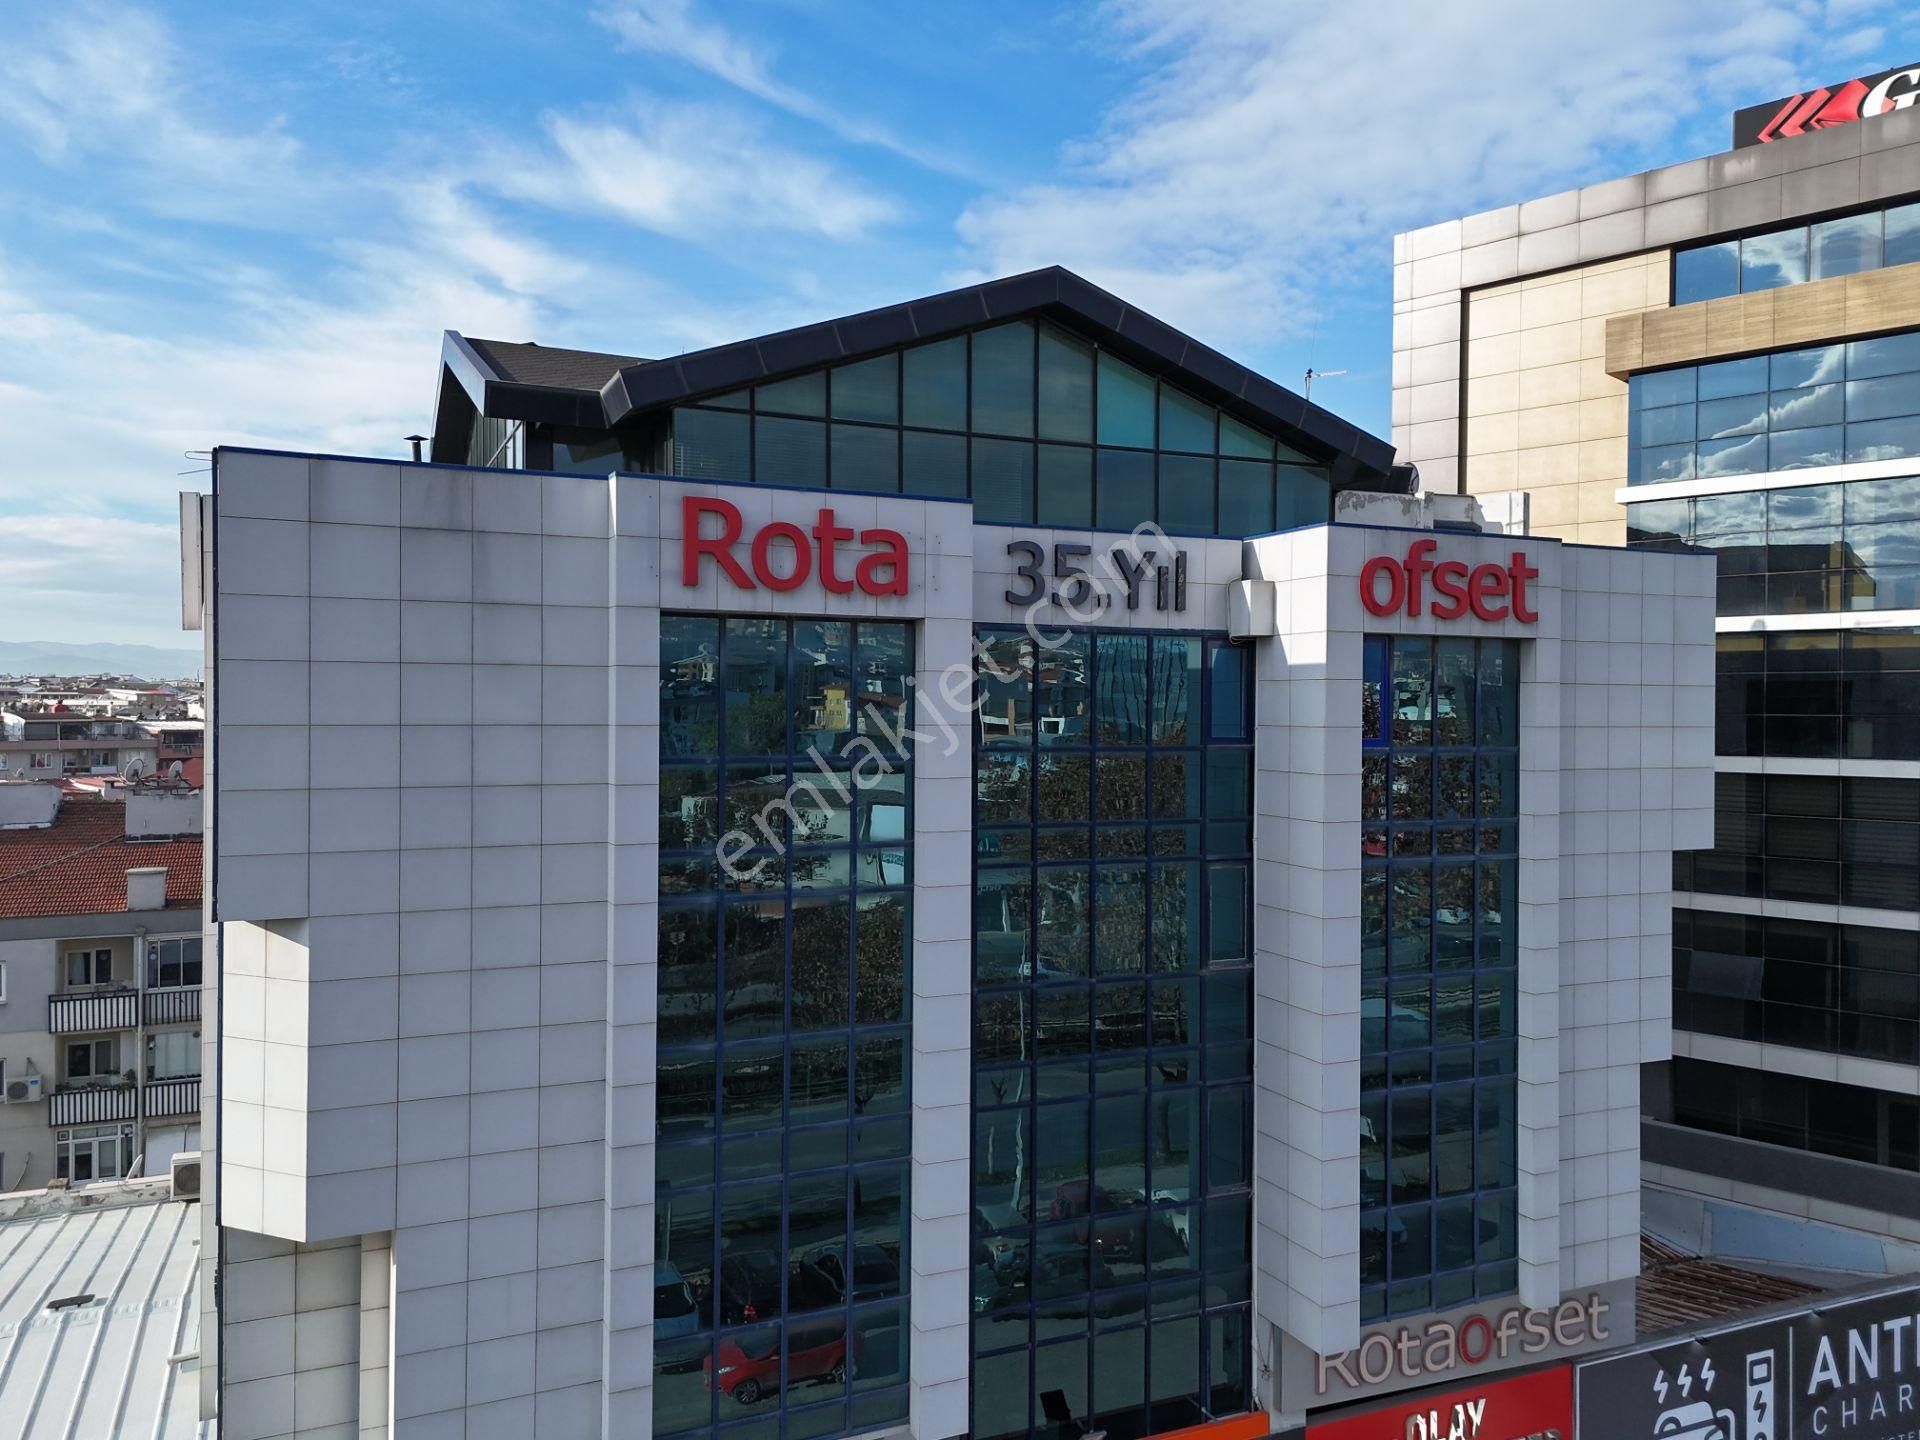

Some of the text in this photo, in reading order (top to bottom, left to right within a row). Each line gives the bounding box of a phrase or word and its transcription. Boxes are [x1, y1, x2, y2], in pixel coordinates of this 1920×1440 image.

[682, 495, 909, 597] Rota
[1360, 538, 1539, 625] ofset
[1812, 1383, 1913, 1435] CHAR
